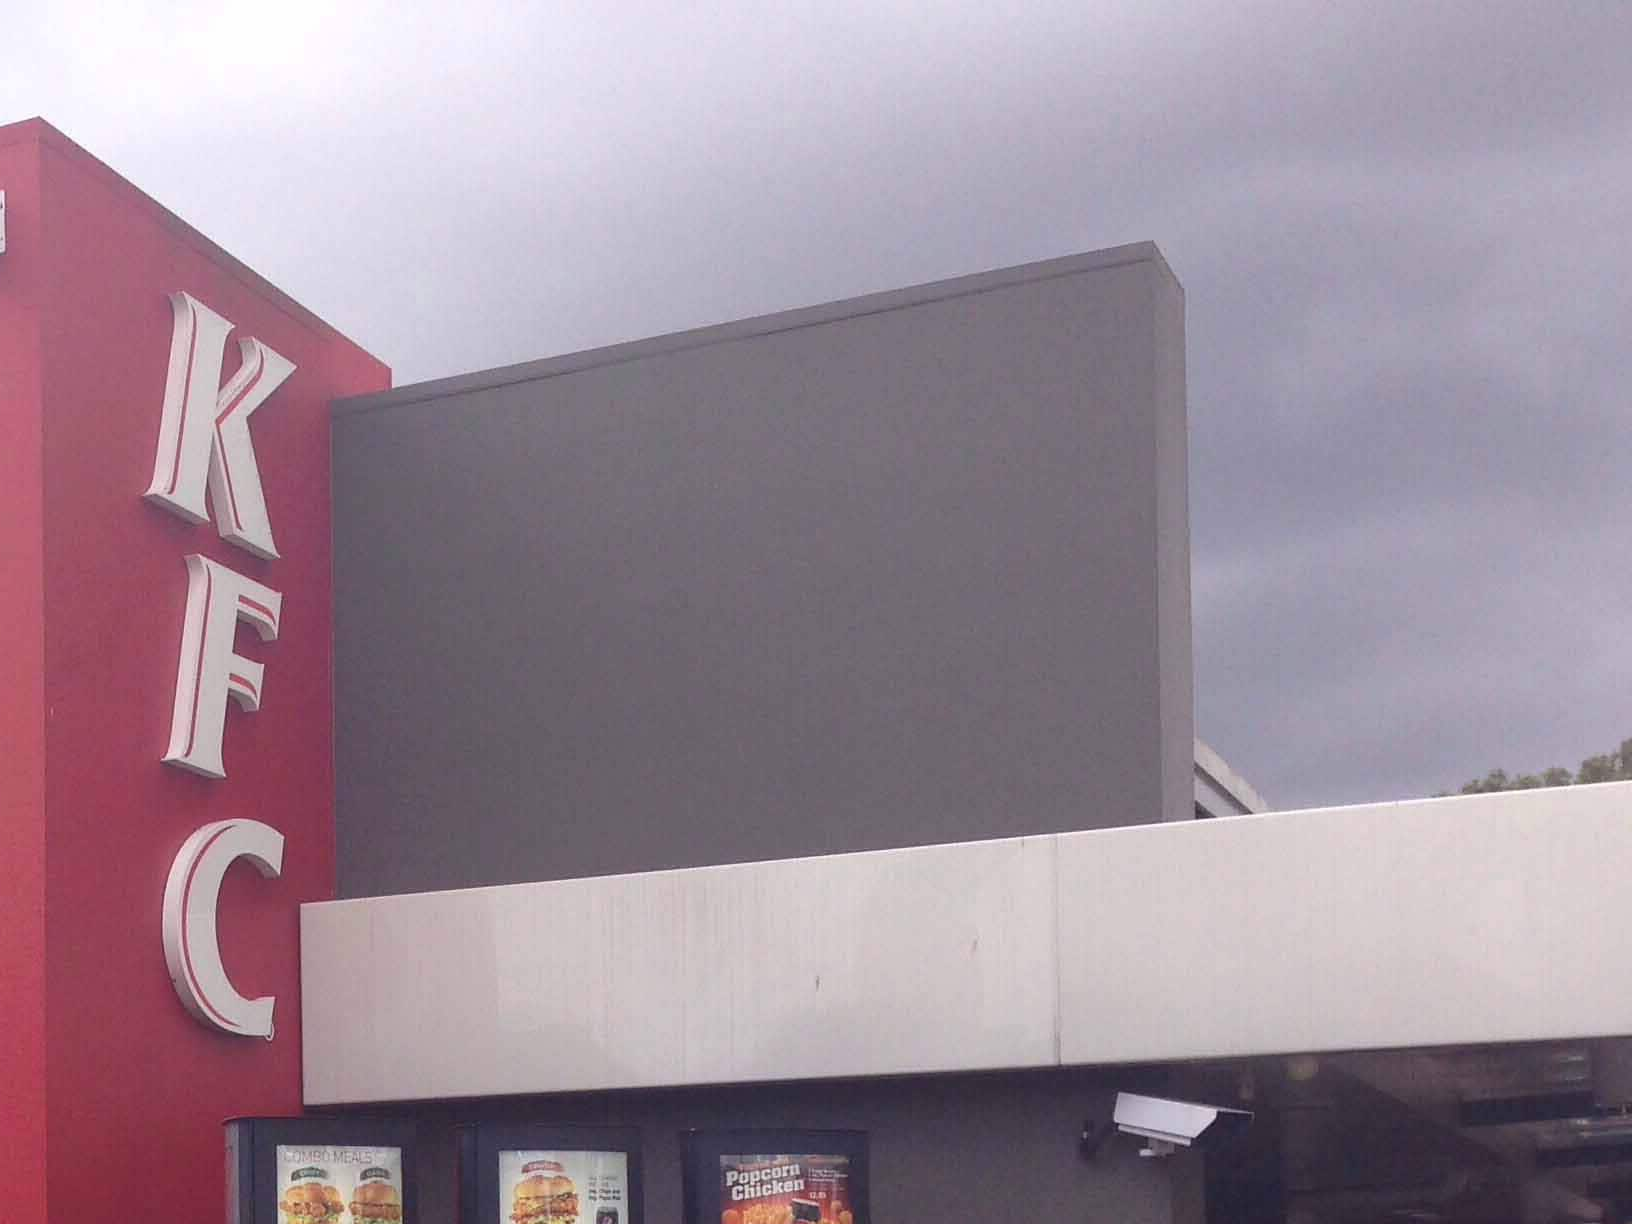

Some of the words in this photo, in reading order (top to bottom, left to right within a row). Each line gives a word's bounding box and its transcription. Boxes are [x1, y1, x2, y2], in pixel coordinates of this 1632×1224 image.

[140, 290, 298, 1040] KFC
[284, 1150, 332, 1163] COMBO
[334, 1150, 373, 1165] MEALS
[725, 1163, 801, 1187] Popcorn
[731, 1178, 805, 1201] Chicken
